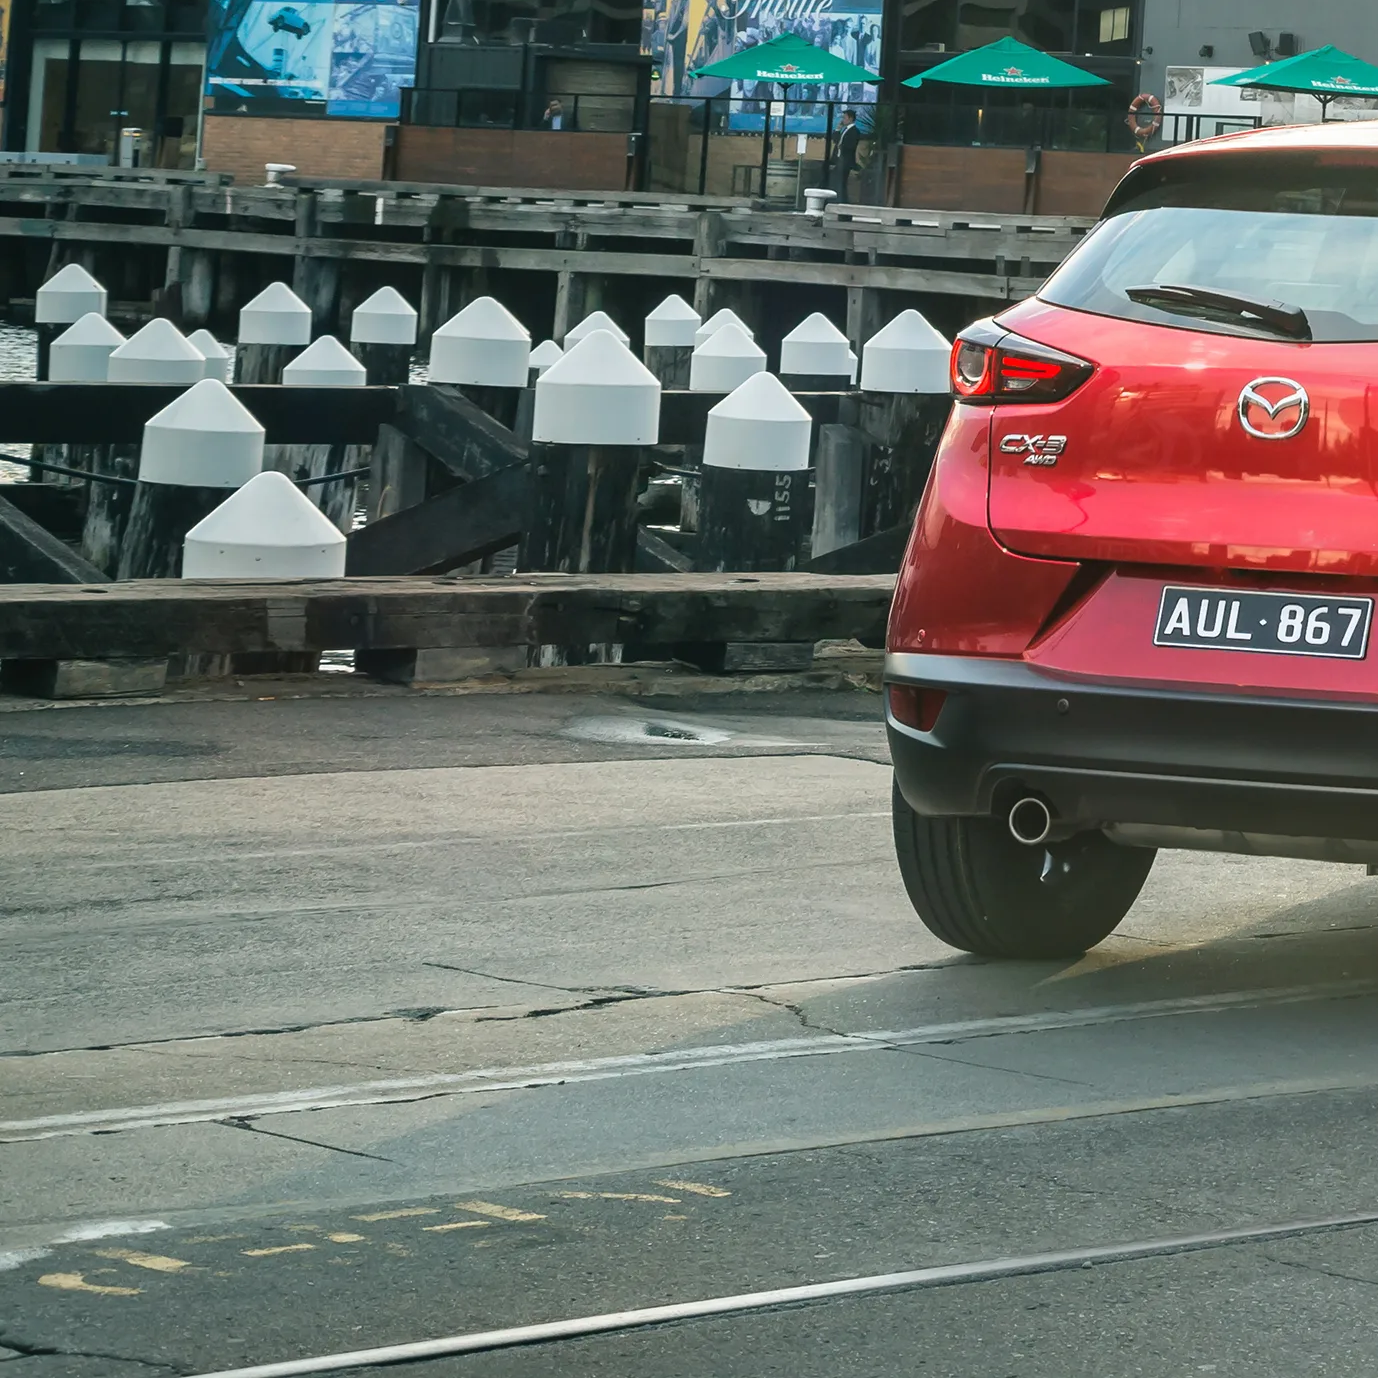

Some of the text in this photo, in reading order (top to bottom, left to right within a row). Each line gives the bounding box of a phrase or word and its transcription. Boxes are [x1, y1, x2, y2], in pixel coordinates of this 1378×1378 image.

[756, 69, 825, 80] Heineken
[981, 73, 1050, 84] Heineken
[1000, 433, 1068, 454] CX-3
[1023, 454, 1057, 465] AWD
[1163, 597, 1363, 648] AUL 867
